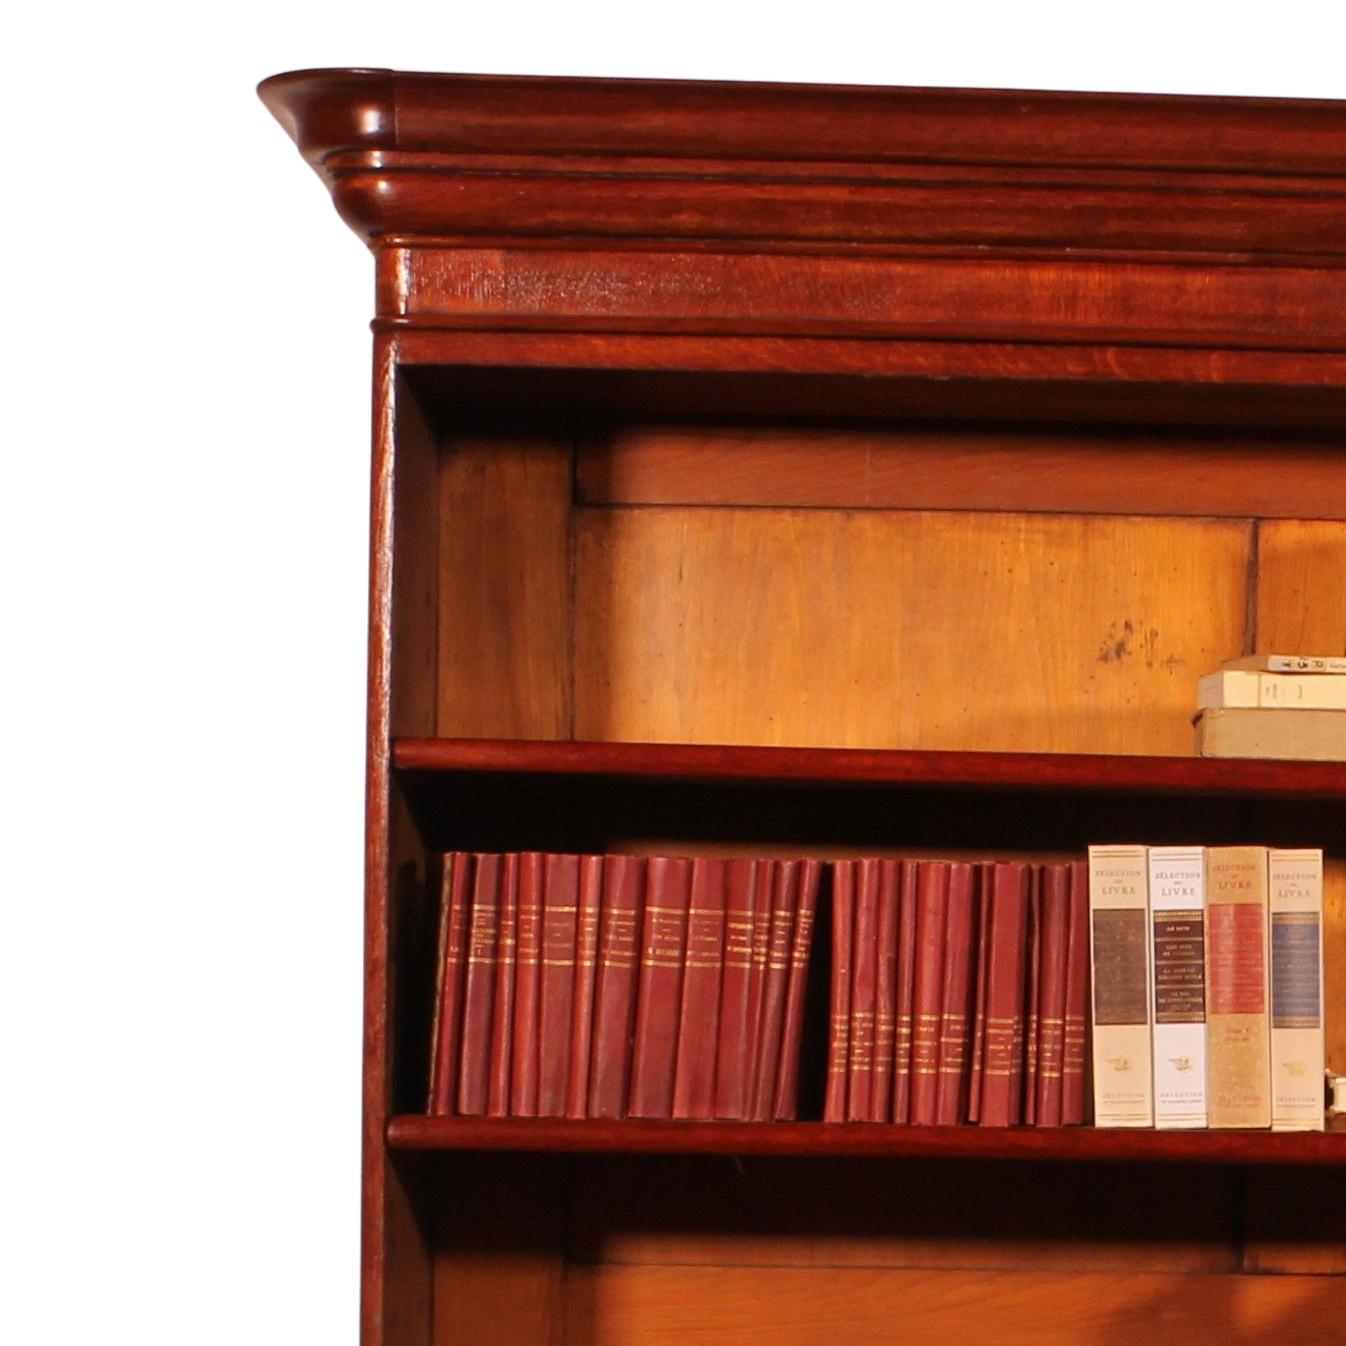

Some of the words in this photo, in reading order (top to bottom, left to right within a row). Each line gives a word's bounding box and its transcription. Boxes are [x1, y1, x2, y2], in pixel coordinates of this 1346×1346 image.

[1218, 880, 1252, 890] LIVRE
[1102, 886, 1136, 895] LIVRE
[1161, 888, 1195, 897] LIVRE
[1278, 890, 1311, 898] LIVRE
